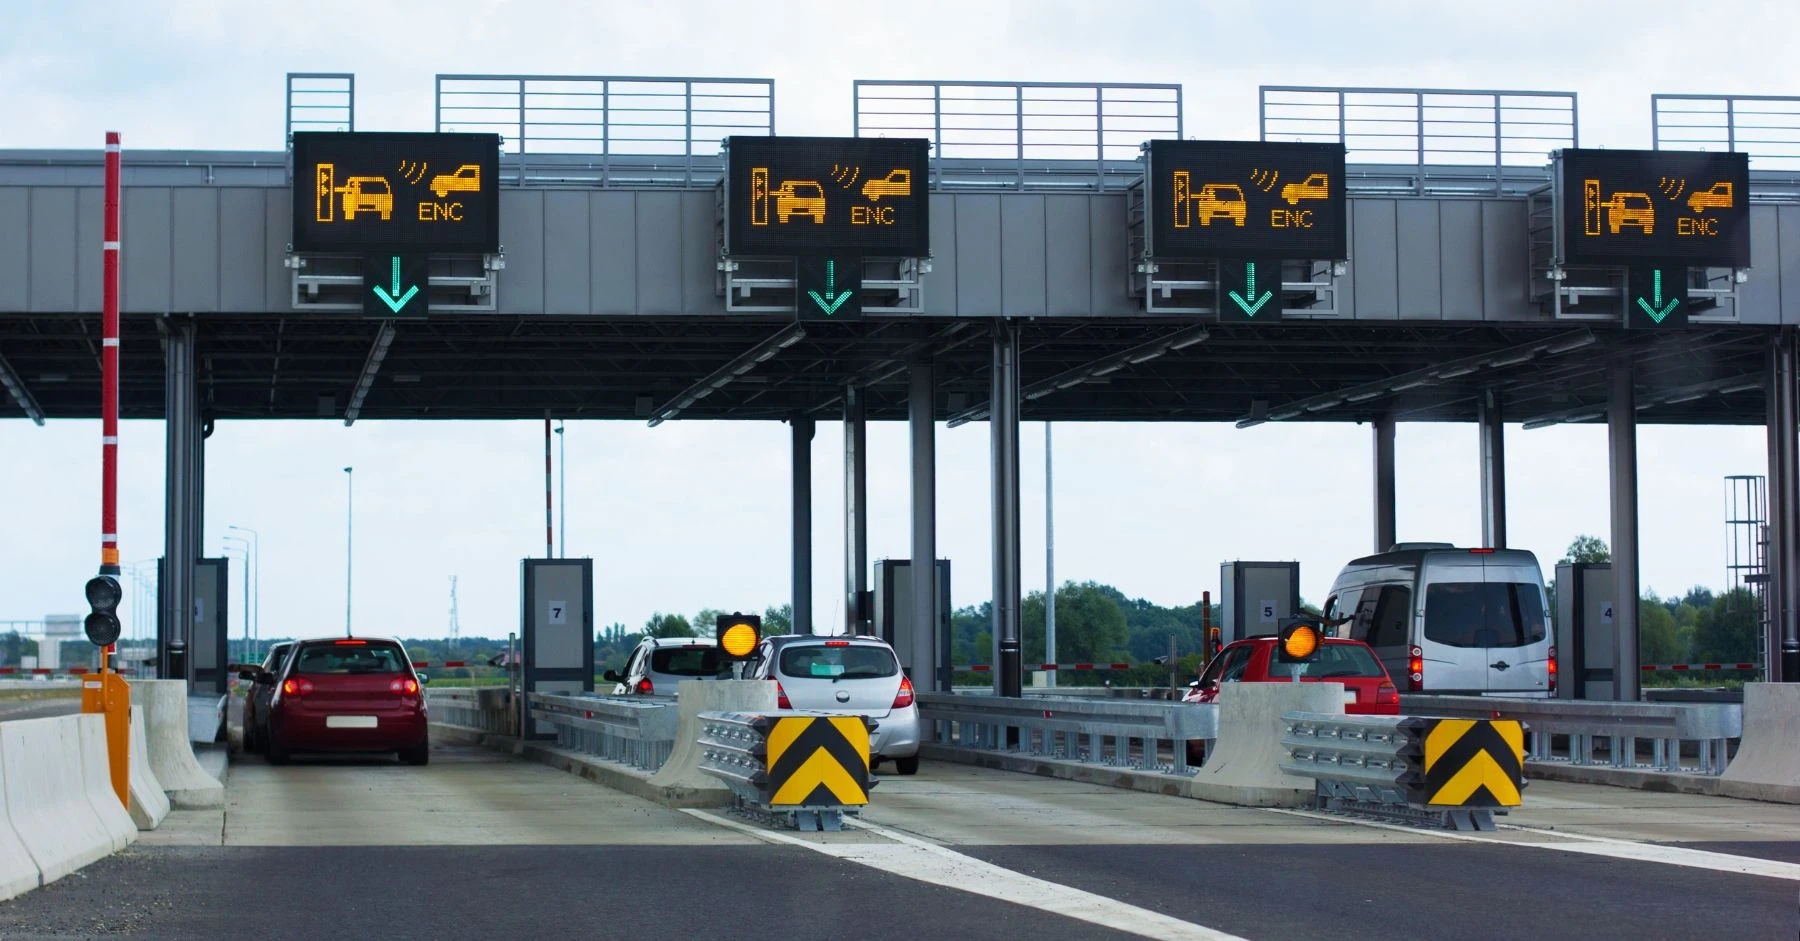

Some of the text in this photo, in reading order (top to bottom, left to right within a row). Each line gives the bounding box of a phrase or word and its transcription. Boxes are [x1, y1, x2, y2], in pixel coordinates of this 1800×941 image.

[419, 202, 463, 221] ENC
[851, 206, 895, 225] ENC
[1271, 209, 1313, 228] ENC
[1678, 217, 1719, 236] ENC
[552, 607, 562, 619] 7
[1263, 606, 1273, 618] 5
[1604, 607, 1612, 618] 4
